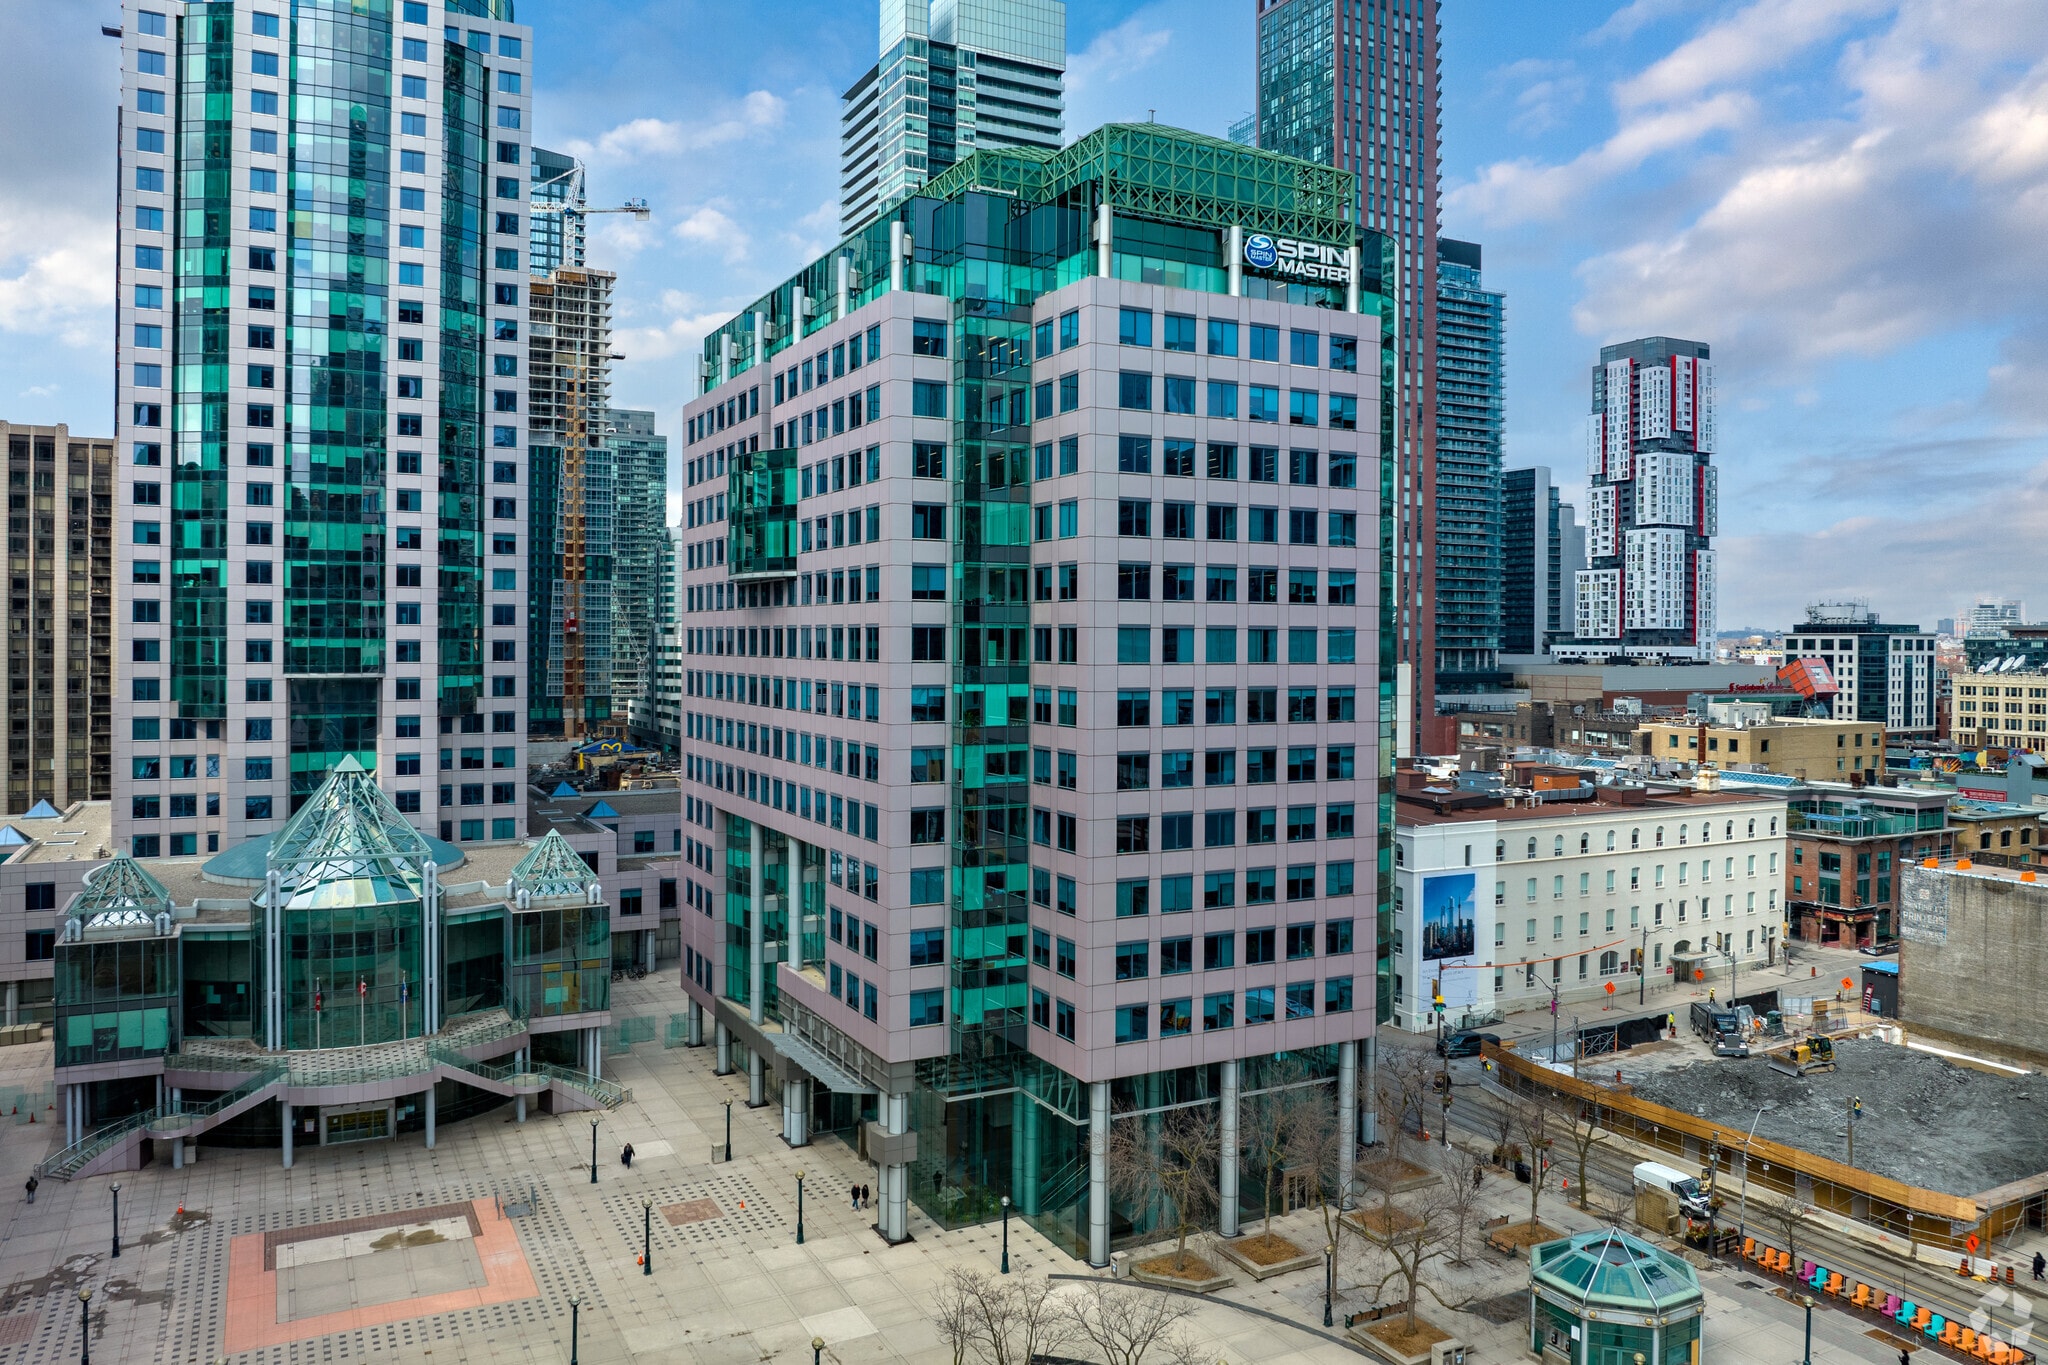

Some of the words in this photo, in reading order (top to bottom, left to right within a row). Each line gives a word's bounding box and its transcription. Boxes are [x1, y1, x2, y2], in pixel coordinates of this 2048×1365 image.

[1250, 249, 1273, 258] SPIN
[1277, 239, 1350, 267] SPIN
[1278, 257, 1350, 283] MASTER
